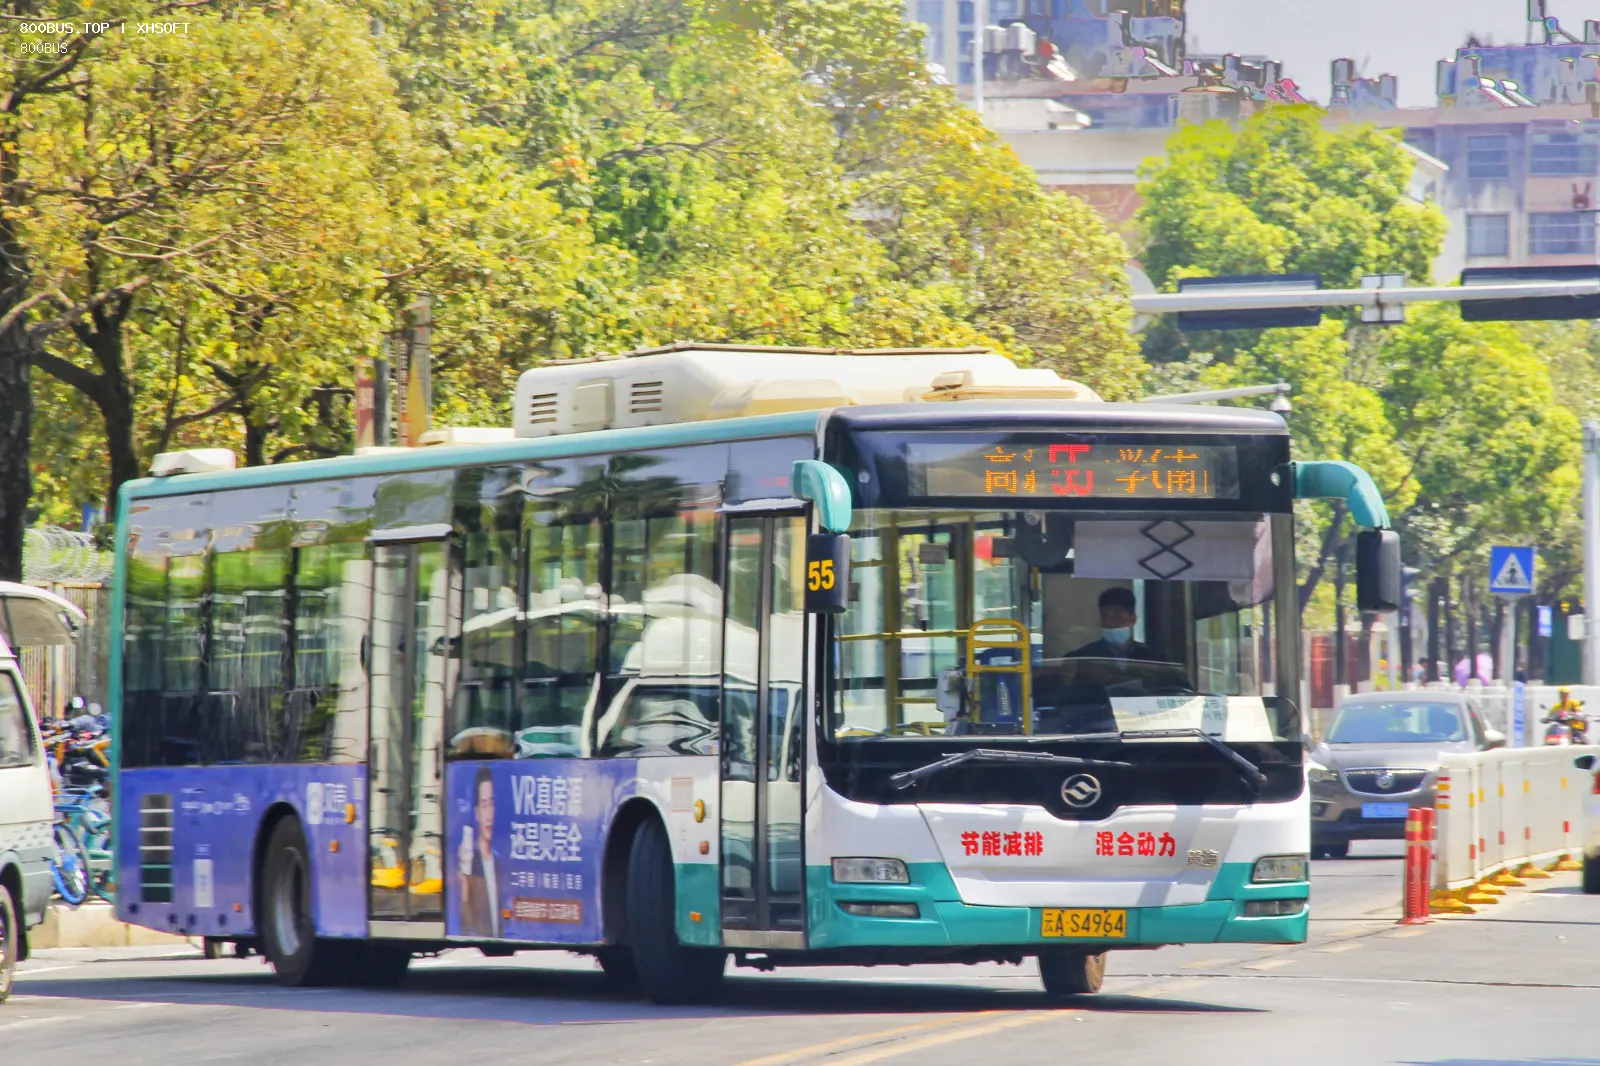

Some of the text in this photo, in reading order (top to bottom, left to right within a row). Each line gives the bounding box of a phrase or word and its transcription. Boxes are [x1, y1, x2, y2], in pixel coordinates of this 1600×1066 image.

[808, 559, 835, 591] 55
[510, 774, 583, 816] VR真房源
[961, 831, 1177, 857] 节能减排 混合动力
